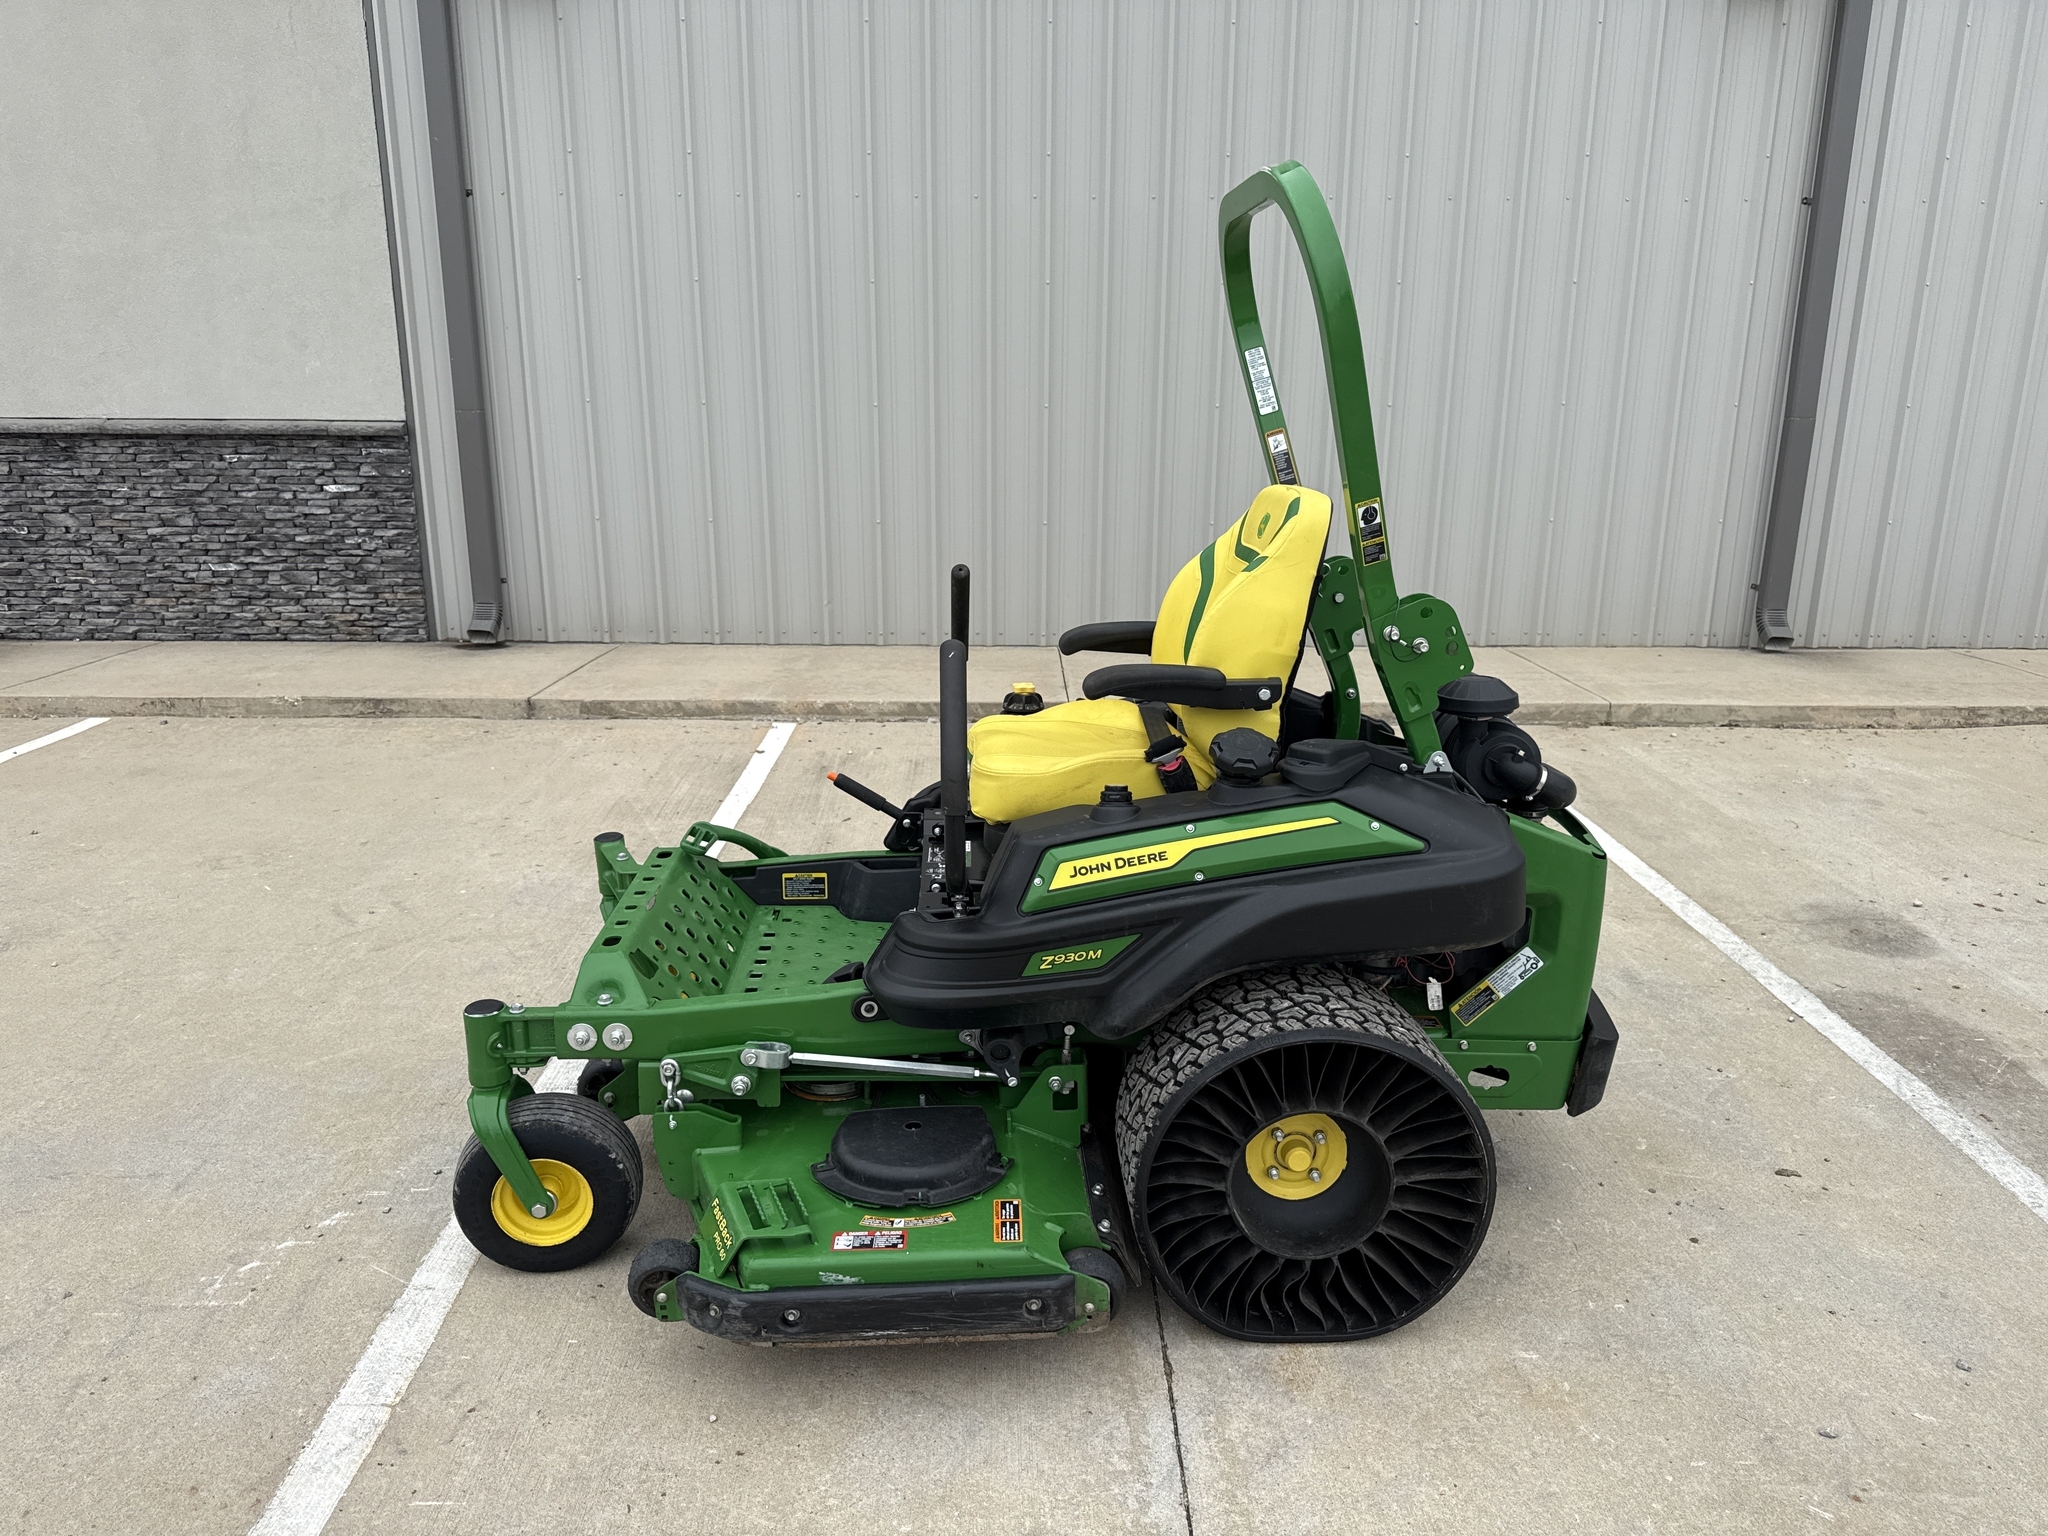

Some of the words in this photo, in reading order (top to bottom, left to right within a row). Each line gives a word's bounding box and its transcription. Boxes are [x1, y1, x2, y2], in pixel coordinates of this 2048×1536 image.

[1069, 861, 1112, 879] JOHN
[1114, 851, 1168, 870] DEERE
[1039, 949, 1102, 970] Z930M
[711, 1197, 733, 1250] FastBack
[713, 1231, 723, 1251] PRO
[719, 1248, 726, 1261] 60
